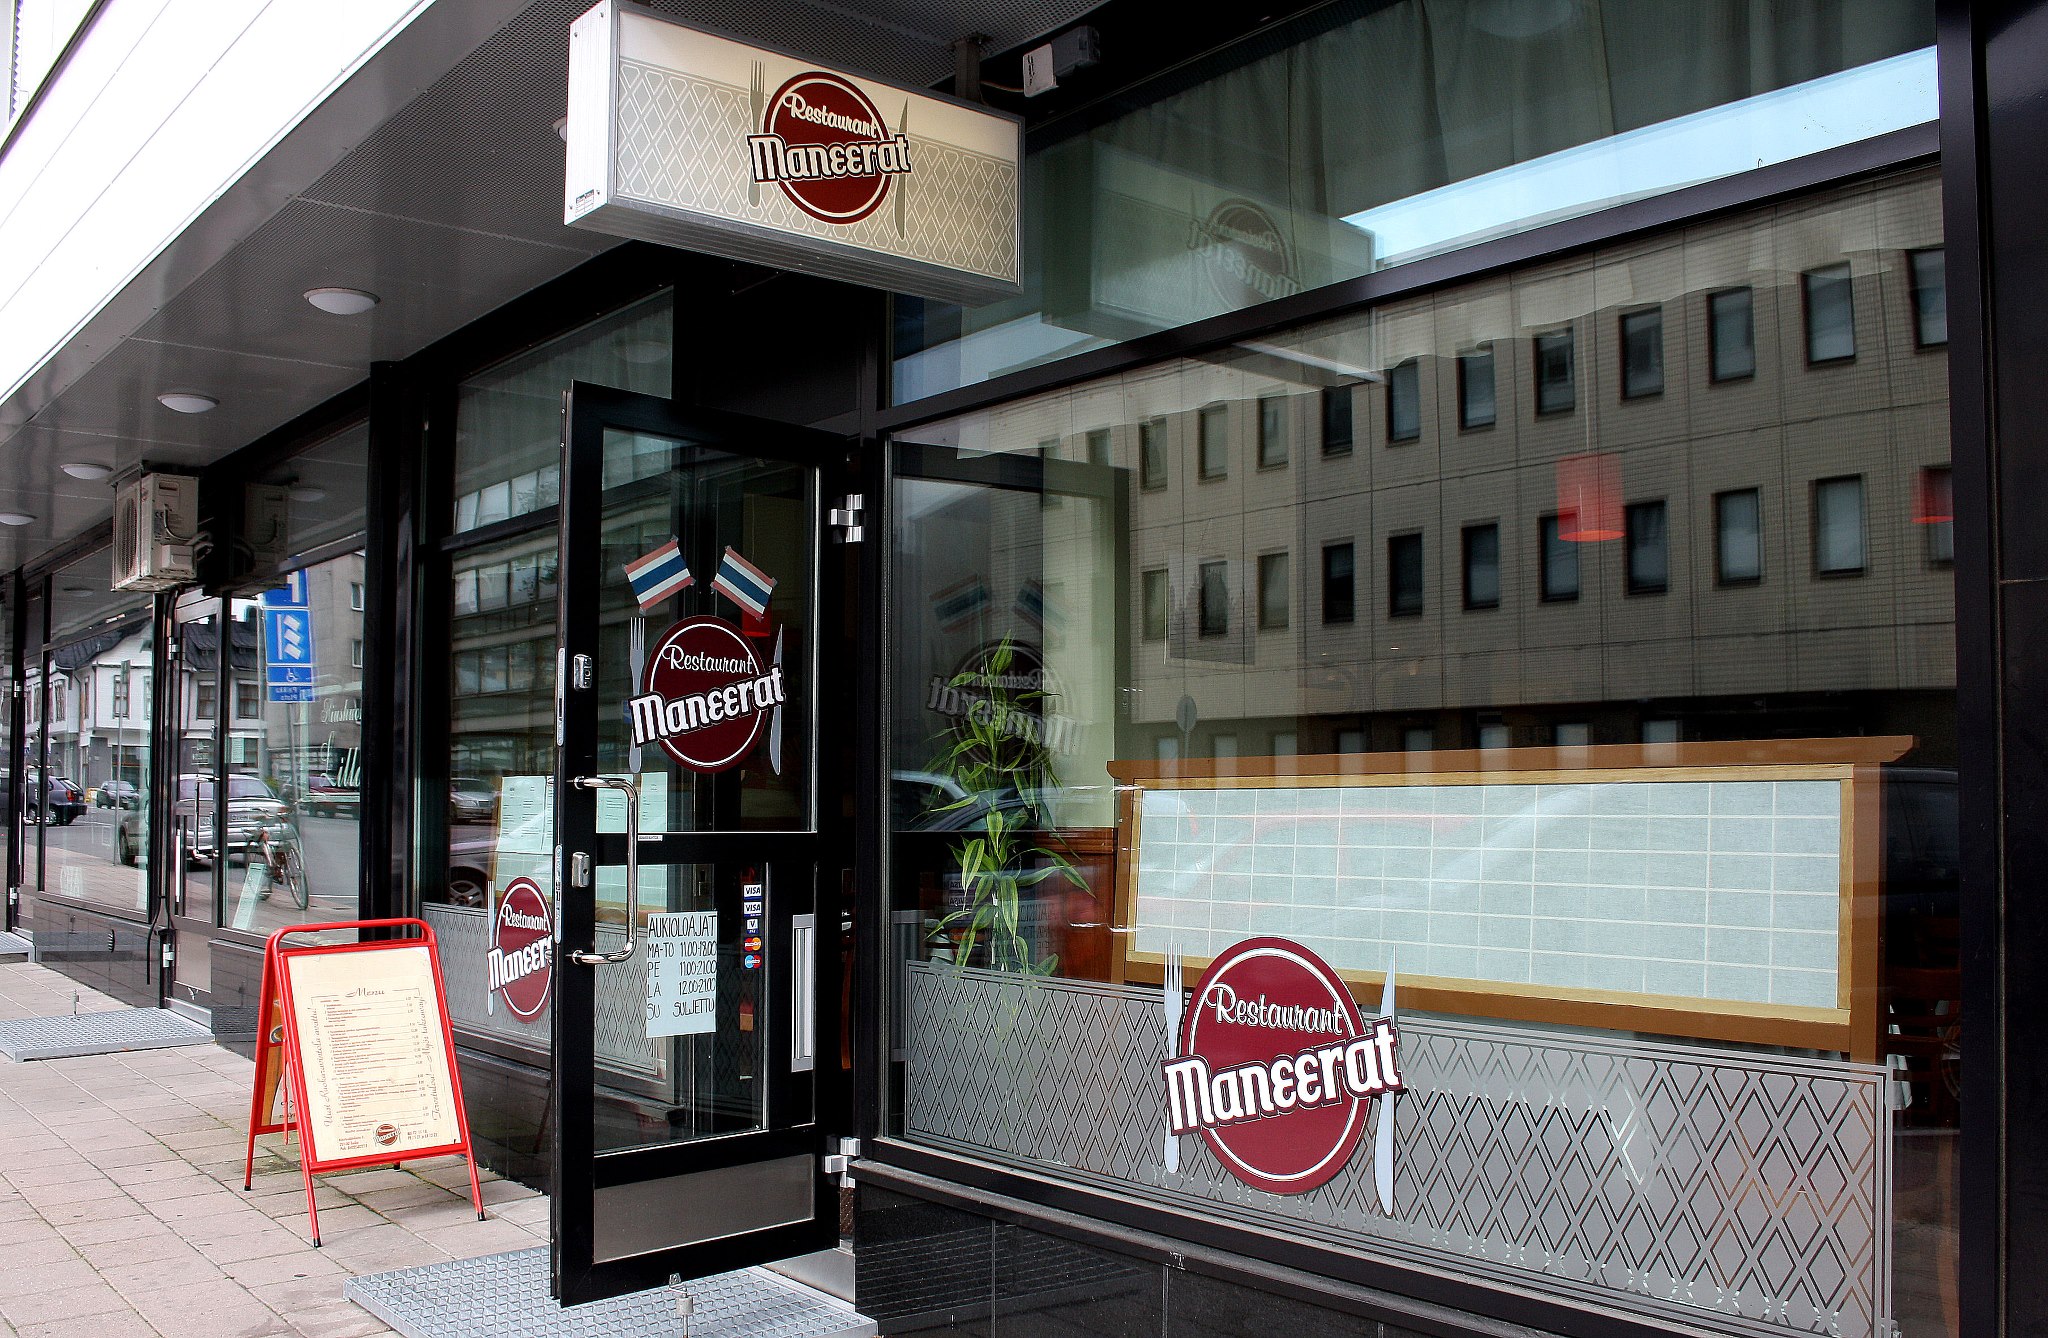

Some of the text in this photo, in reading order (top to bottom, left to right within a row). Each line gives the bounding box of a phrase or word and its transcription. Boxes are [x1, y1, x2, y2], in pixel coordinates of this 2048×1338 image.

[783, 92, 877, 138] Restaurant
[748, 134, 911, 182] Maneerat
[662, 645, 753, 674] Restaurant
[629, 666, 786, 746] Maneerat
[745, 887, 761, 895] VISA
[501, 903, 547, 932] Restaurant
[745, 904, 761, 912] VISA
[648, 914, 717, 938] AUKIOLOAJAT
[647, 941, 675, 958] MA-TO
[647, 961, 661, 978] PE
[345, 987, 385, 998] Menu
[647, 982, 662, 998] LA
[647, 998, 715, 1021] SU SULJETTU
[1205, 983, 1343, 1034] Restaurant
[1163, 1021, 1403, 1133] Maneerat
